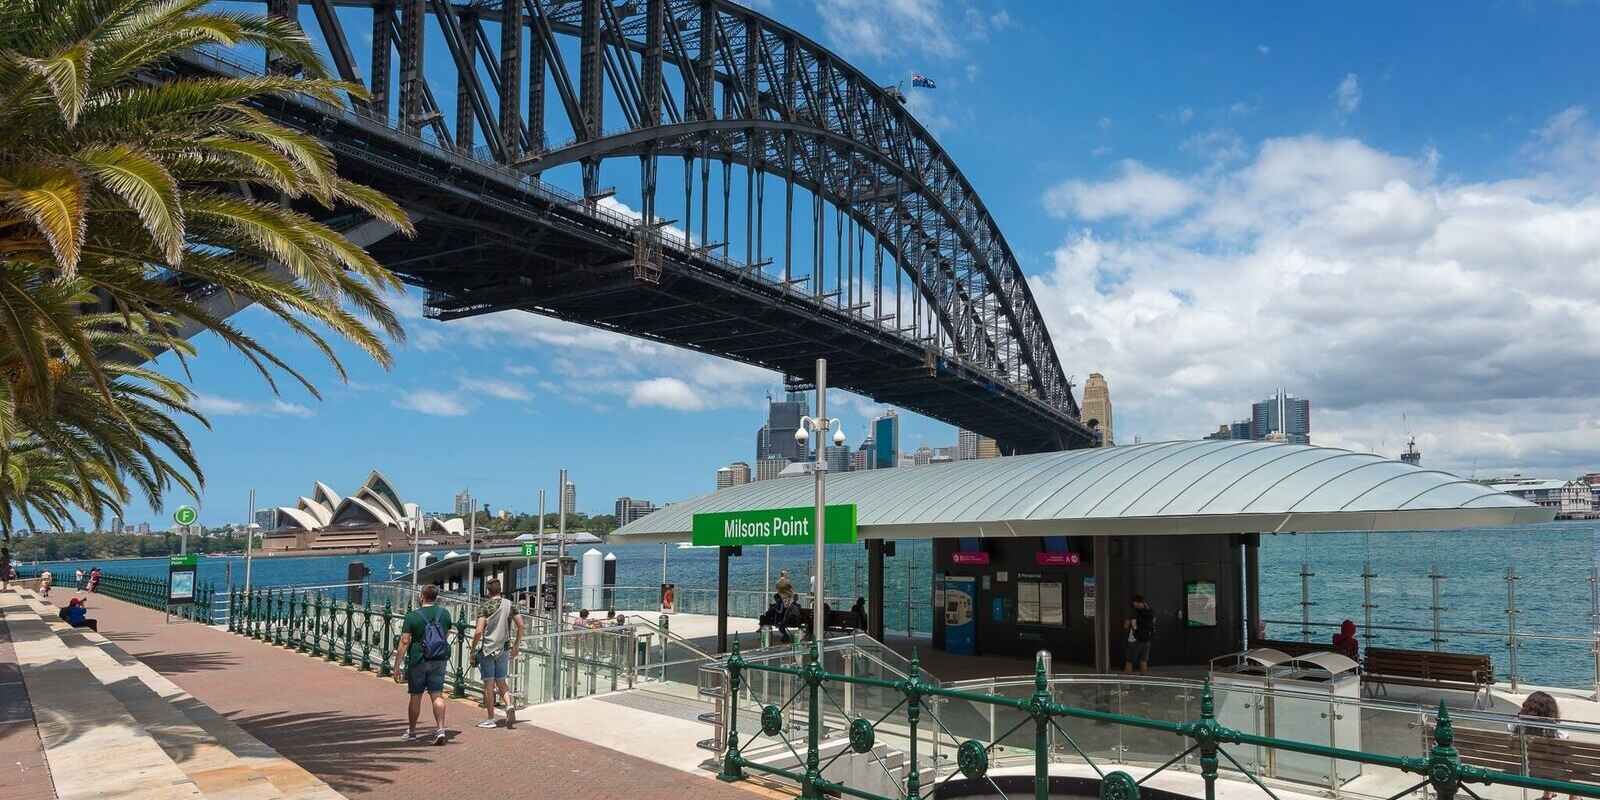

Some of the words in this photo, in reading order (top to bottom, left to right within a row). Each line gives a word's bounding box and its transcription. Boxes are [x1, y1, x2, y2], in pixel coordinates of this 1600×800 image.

[182, 510, 190, 521] F
[724, 518, 770, 538] Milsons
[773, 516, 808, 536] Point
[526, 548, 532, 556] B
